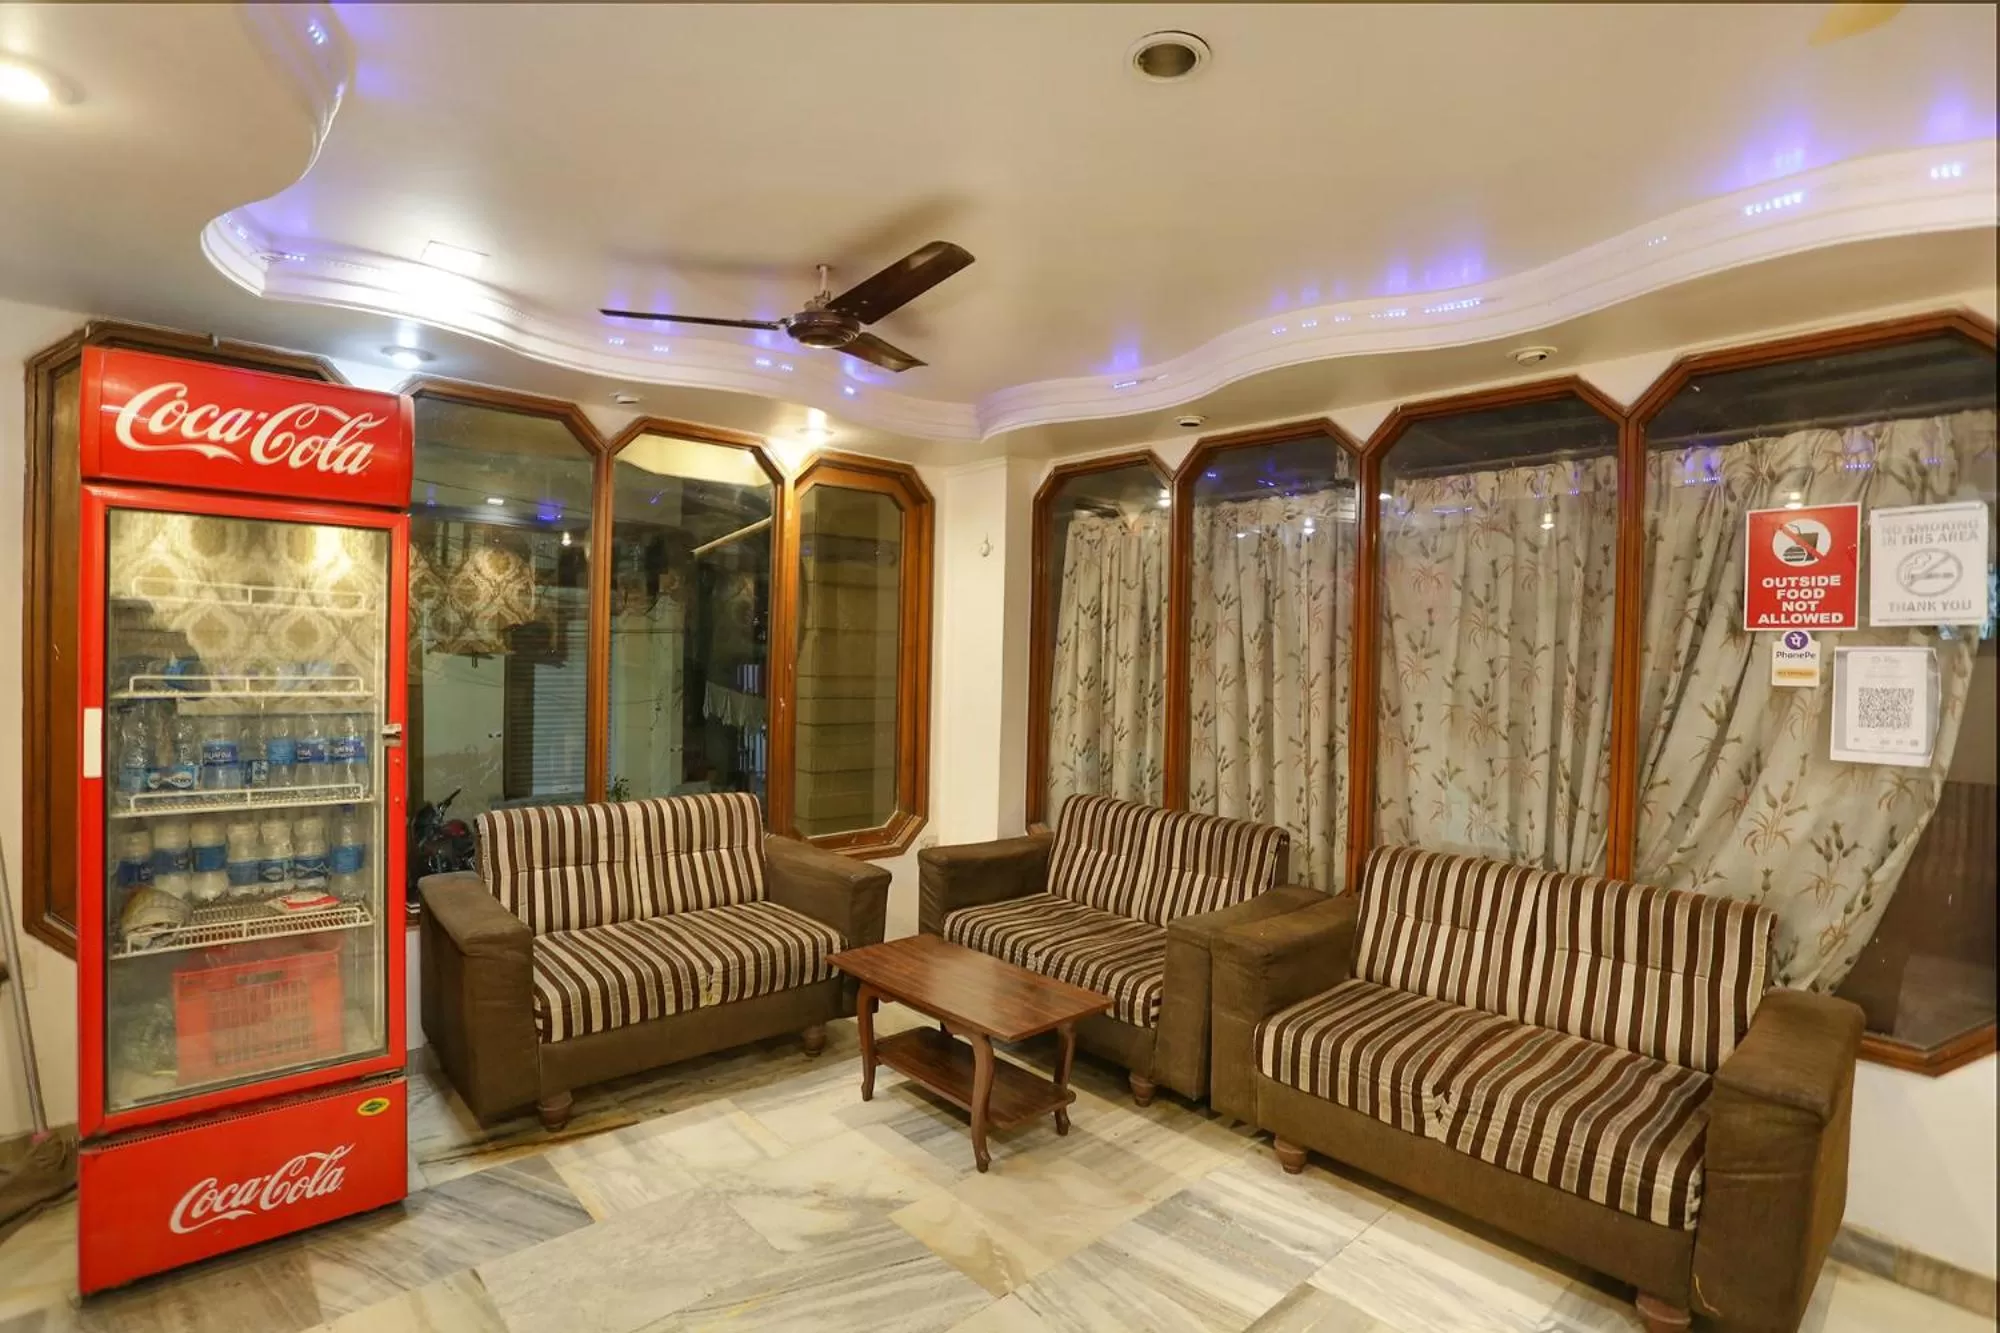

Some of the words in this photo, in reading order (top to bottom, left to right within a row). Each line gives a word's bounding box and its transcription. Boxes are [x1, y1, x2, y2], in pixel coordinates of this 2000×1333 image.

[115, 382, 388, 475] Coca-Cola
[1881, 525, 1901, 535] NO
[1906, 519, 1979, 534] SMOKING
[1882, 535, 1897, 547] IN
[1902, 534, 1934, 545] THIS
[1937, 530, 1979, 543] AREA
[1761, 575, 1841, 588] OUTSIDE
[1776, 588, 1826, 600] FOOD
[1782, 600, 1820, 612] NOT
[1888, 600, 1936, 613] THANK
[1941, 599, 1972, 612] YOU
[1758, 612, 1844, 625] ALLOWED
[1775, 651, 1816, 659] PhonePe
[169, 1143, 356, 1234] Coca-Cola
